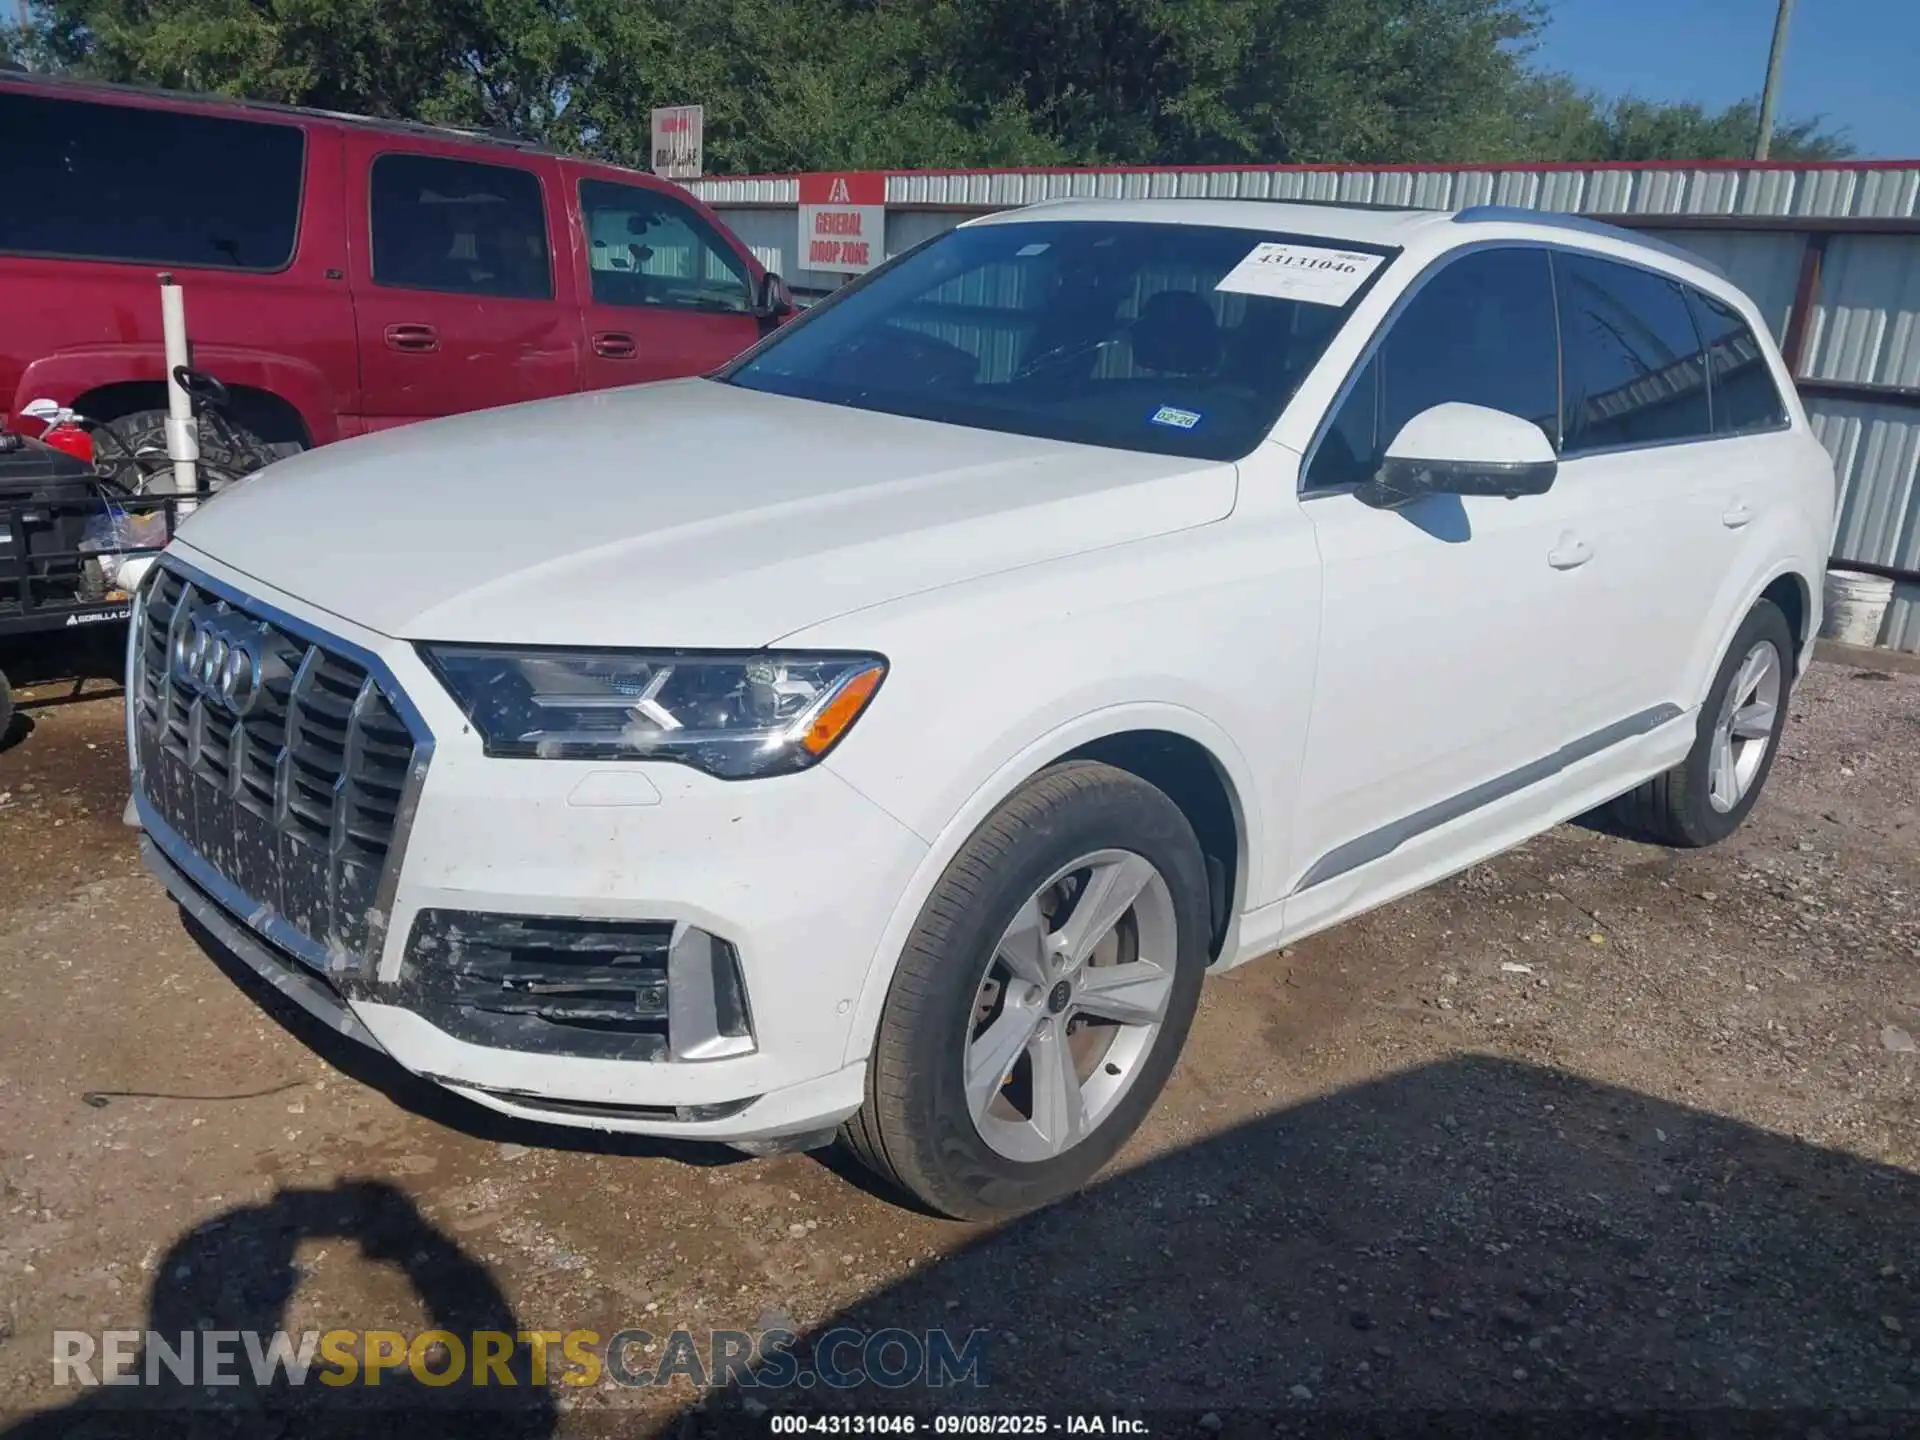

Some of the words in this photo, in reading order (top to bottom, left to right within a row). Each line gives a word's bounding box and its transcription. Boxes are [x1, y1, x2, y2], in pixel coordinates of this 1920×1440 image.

[815, 211, 862, 236] GENERAL
[809, 240, 840, 265] DROP
[841, 241, 870, 266] ZONE
[1258, 254, 1356, 274] 43131046
[78, 612, 117, 622] GORILLA
